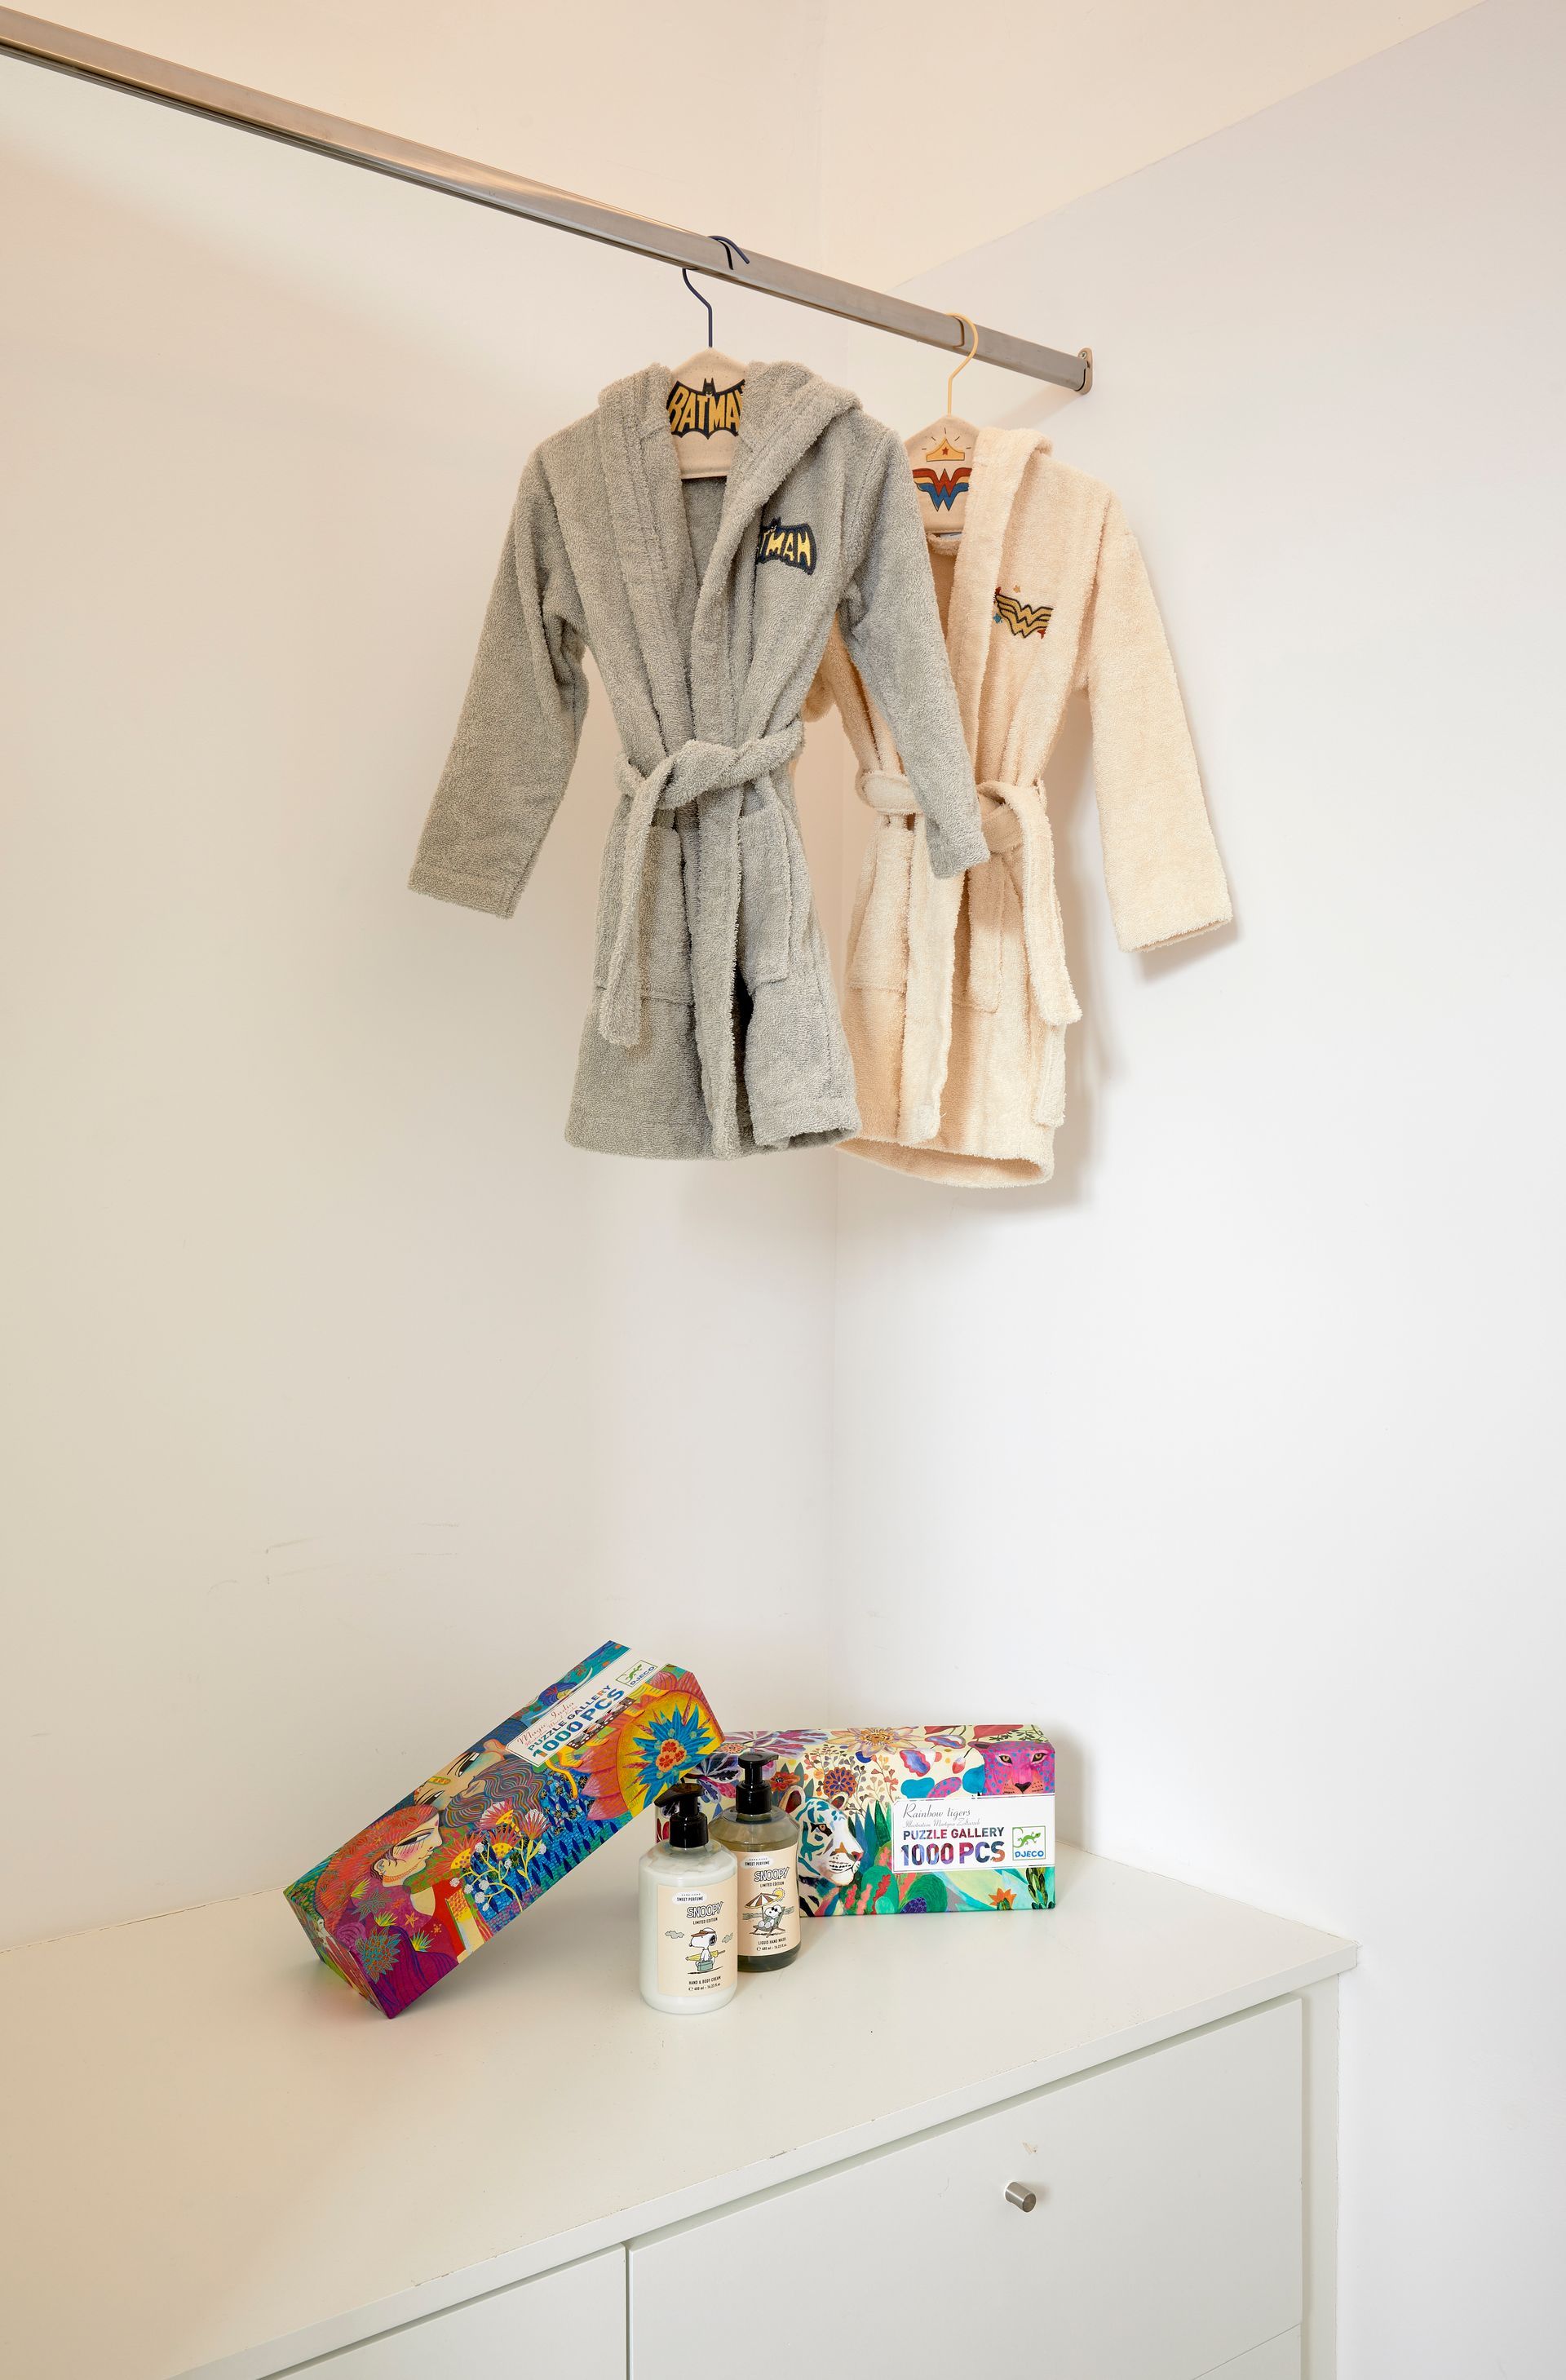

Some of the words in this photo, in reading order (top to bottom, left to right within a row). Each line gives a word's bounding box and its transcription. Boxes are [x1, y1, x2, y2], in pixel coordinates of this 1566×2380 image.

[668, 384, 744, 433] BATMA
[759, 530, 812, 567] TMAN
[630, 1666, 655, 1686] DJECO
[528, 1720, 568, 1751] PUZZLE
[567, 1684, 611, 1720] GALLERY
[533, 1721, 583, 1758] 1000
[580, 1688, 625, 1722] PCS
[903, 1803, 944, 1819] Rainbow
[947, 1807, 971, 1820] tigers
[903, 1829, 948, 1840] PUZZLE
[951, 1827, 1005, 1838] GALLERY
[901, 1843, 954, 1866] 1000
[959, 1841, 1006, 1864] PCS
[754, 1866, 790, 1882] SNOOPY
[687, 1901, 723, 1918] SNOOPY
